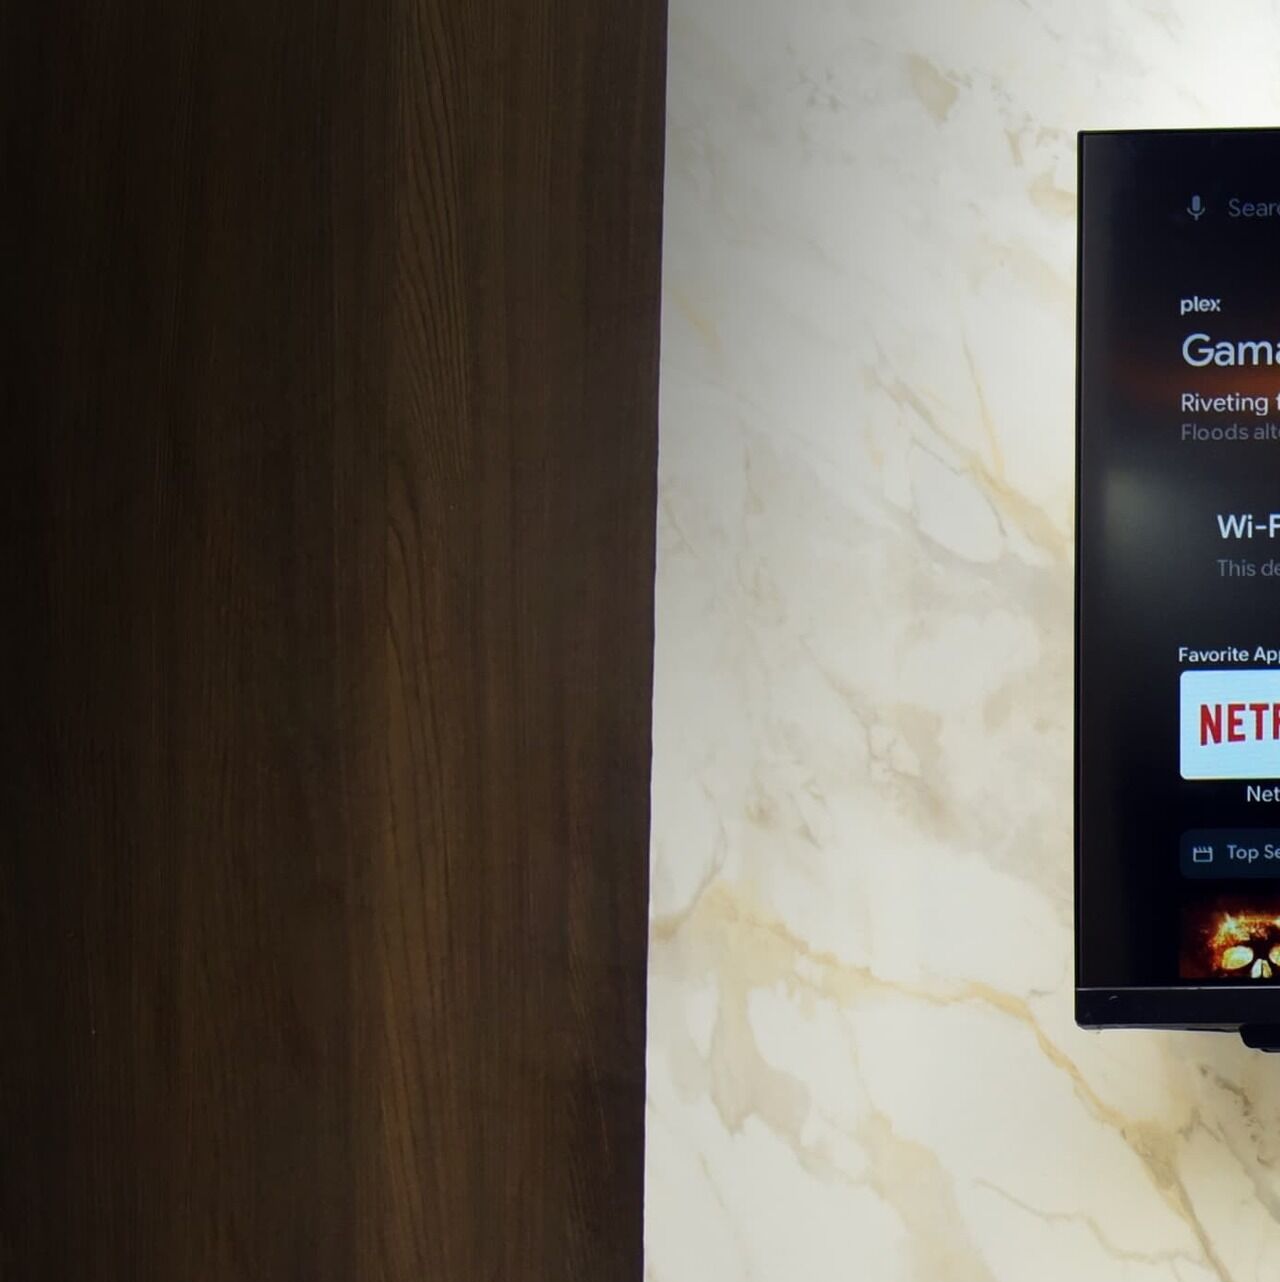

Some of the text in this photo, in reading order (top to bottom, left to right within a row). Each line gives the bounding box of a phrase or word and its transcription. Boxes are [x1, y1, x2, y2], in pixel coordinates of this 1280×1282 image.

[1180, 295, 1221, 316] plex
[1181, 392, 1269, 416] Riveting
[1181, 423, 1249, 441] Floods
[1216, 558, 1257, 577] This
[1178, 646, 1250, 663] Favorite
[1226, 844, 1260, 862] Top
